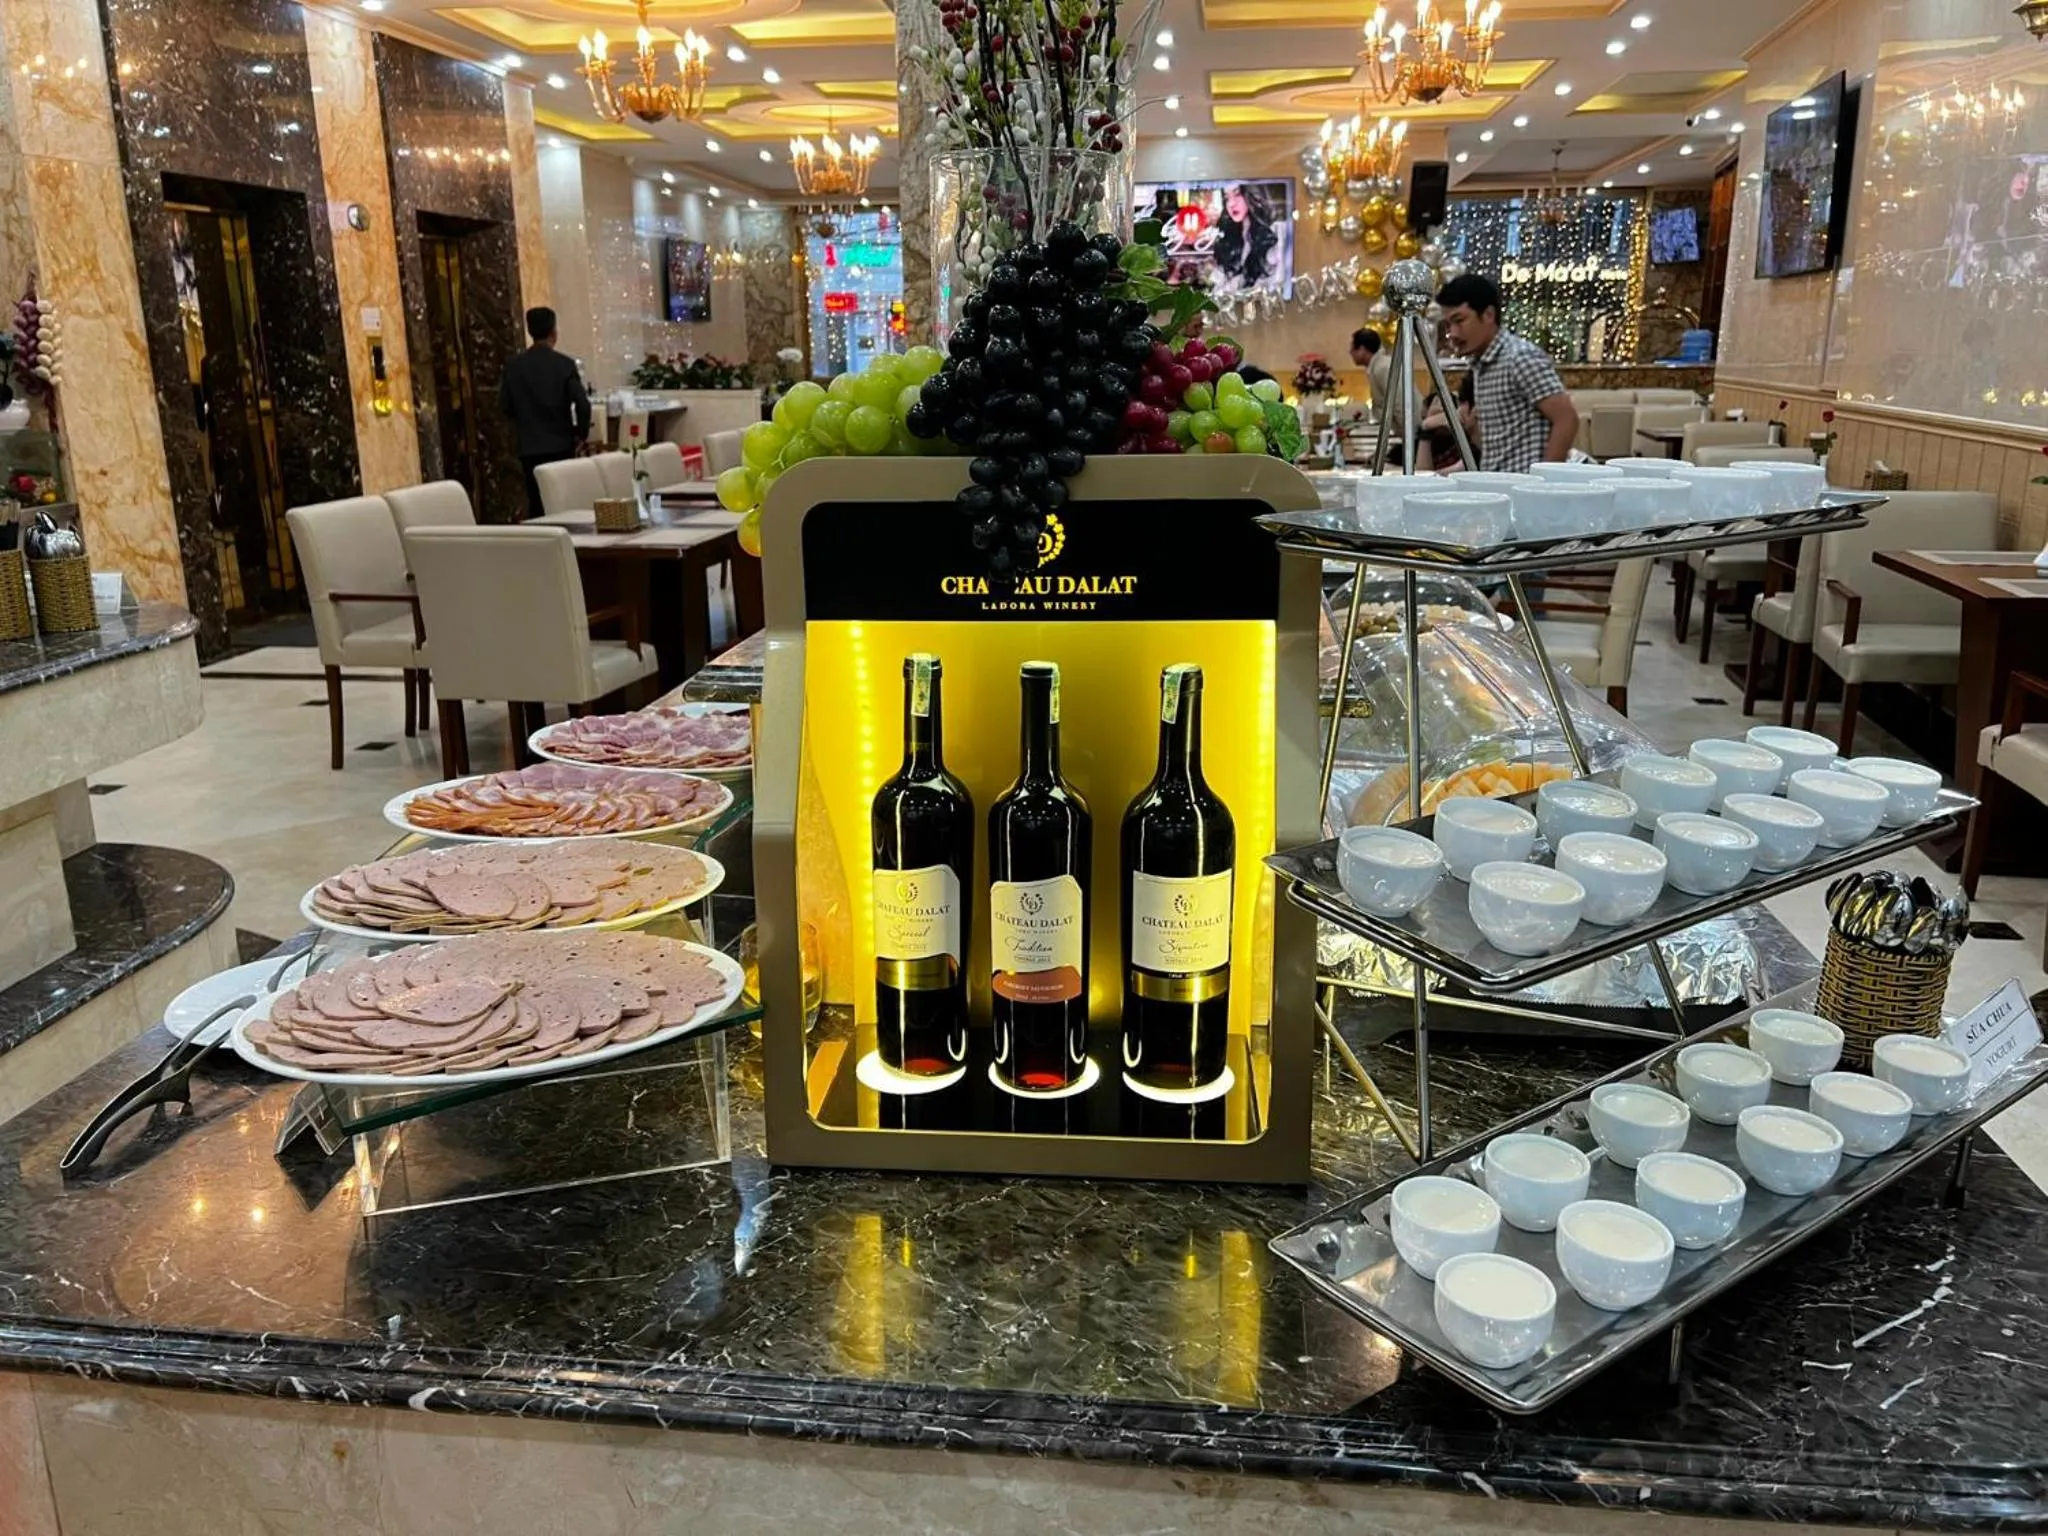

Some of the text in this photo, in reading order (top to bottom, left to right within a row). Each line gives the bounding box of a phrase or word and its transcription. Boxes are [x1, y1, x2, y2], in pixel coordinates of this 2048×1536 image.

[941, 576, 1137, 594] CHAAU DALAT
[982, 601, 1097, 610] LADORA WINERY
[915, 904, 950, 917] DALAT
[995, 912, 1074, 928] CHATEAU DALAT
[1142, 916, 1192, 929] CHATEAU
